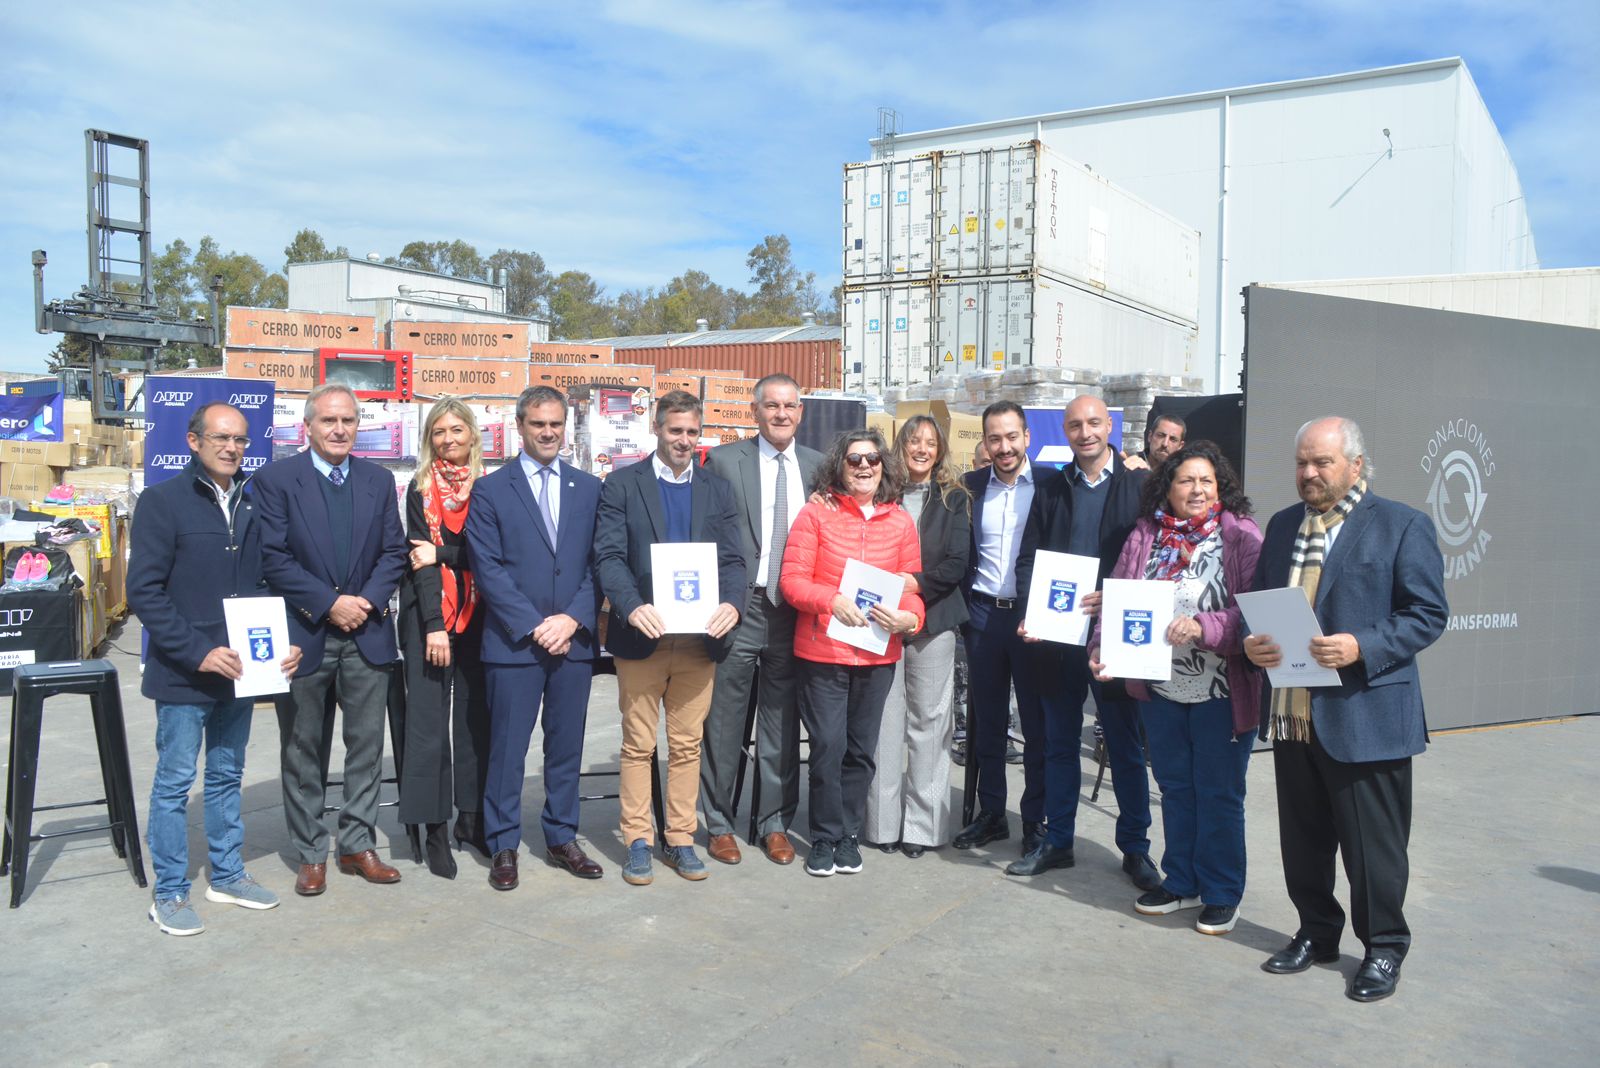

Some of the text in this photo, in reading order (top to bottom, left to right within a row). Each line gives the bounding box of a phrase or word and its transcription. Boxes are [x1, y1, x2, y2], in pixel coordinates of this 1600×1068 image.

[1050, 168, 1058, 240] TRITON
[262, 322, 342, 339] CERRO MOTOS
[424, 333, 498, 347] CERRO MOTOS
[556, 353, 587, 364] MOTOS
[259, 363, 295, 378] CERRO
[422, 369, 496, 384] CERRO MOTOS
[555, 375, 586, 388] CERRO
[657, 382, 681, 391] MOTOS
[723, 385, 745, 395] CERRO
[153, 391, 194, 403] AFIP
[228, 393, 268, 405] AFIP
[721, 409, 743, 419] CERRO
[721, 434, 739, 443] CERR
[957, 430, 971, 439] CERRO
[1420, 418, 1497, 477] DONACIONES
[151, 454, 192, 467] AFIP
[240, 456, 267, 468] FIP
